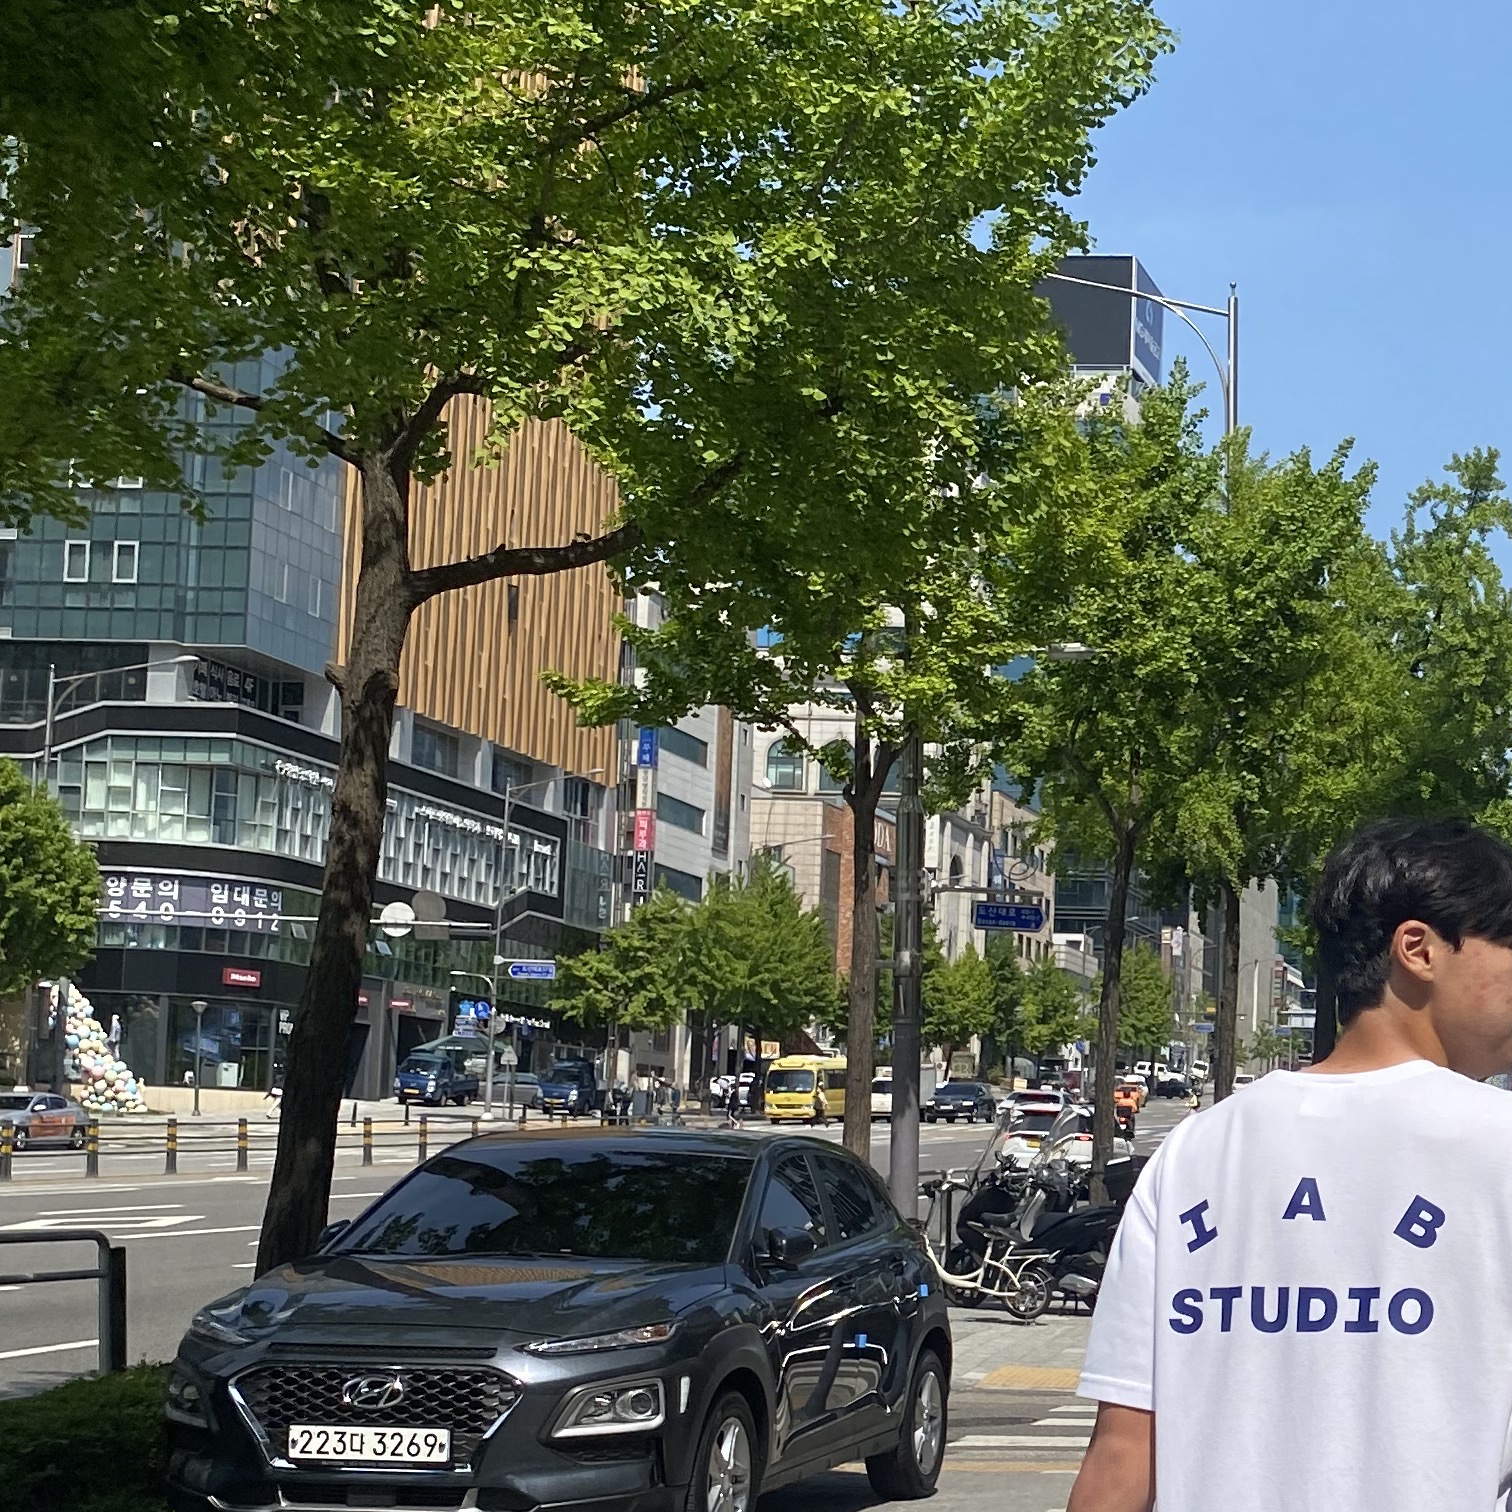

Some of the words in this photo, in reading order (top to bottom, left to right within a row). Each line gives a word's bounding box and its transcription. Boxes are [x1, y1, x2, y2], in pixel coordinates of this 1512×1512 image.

[211, 883, 282, 912] 임대문의
[1169, 1286, 1434, 1335] STUDIO
[299, 1430, 365, 1454] 223다
[373, 1432, 438, 1458] 3269
